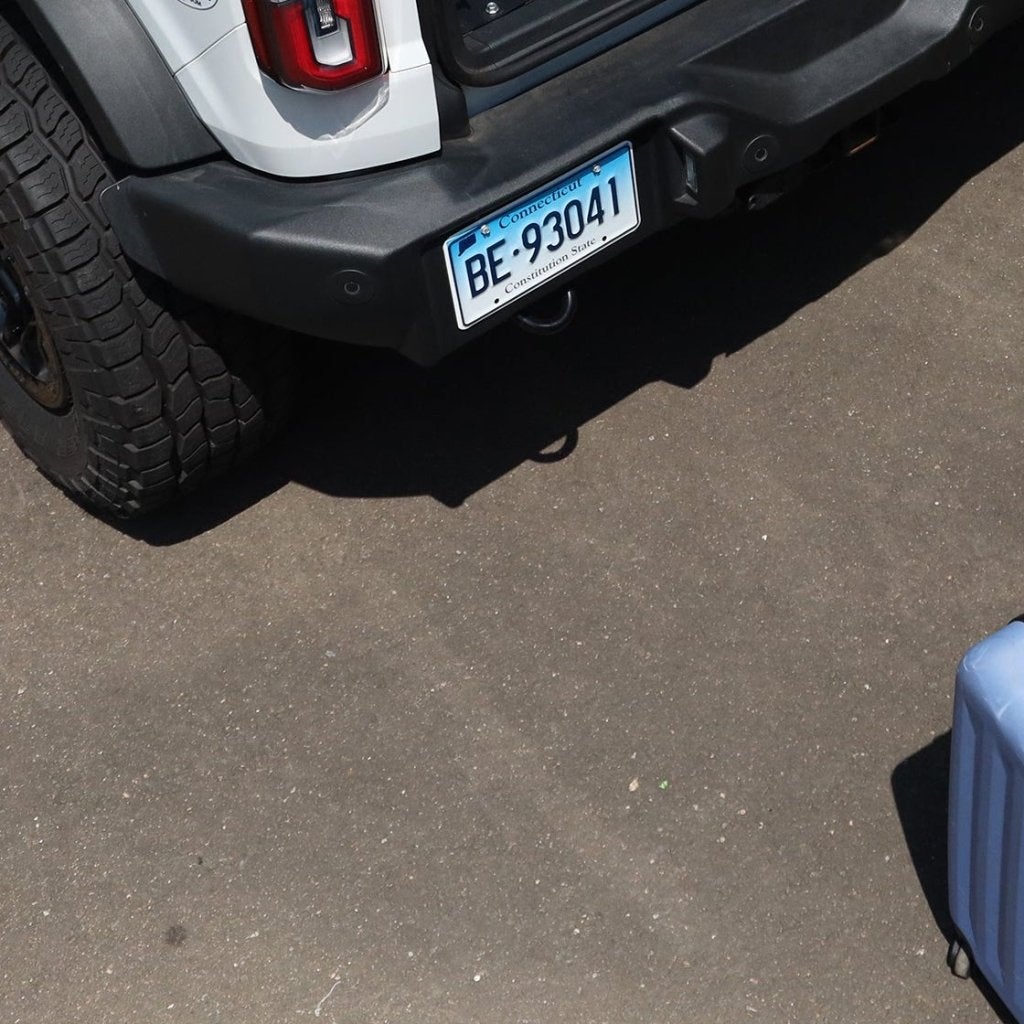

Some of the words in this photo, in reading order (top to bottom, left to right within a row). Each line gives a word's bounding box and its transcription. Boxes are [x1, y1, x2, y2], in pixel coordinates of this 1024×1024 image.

[499, 178, 583, 230] Connecticut
[504, 252, 569, 294] Constitution
[570, 237, 597, 257] State
